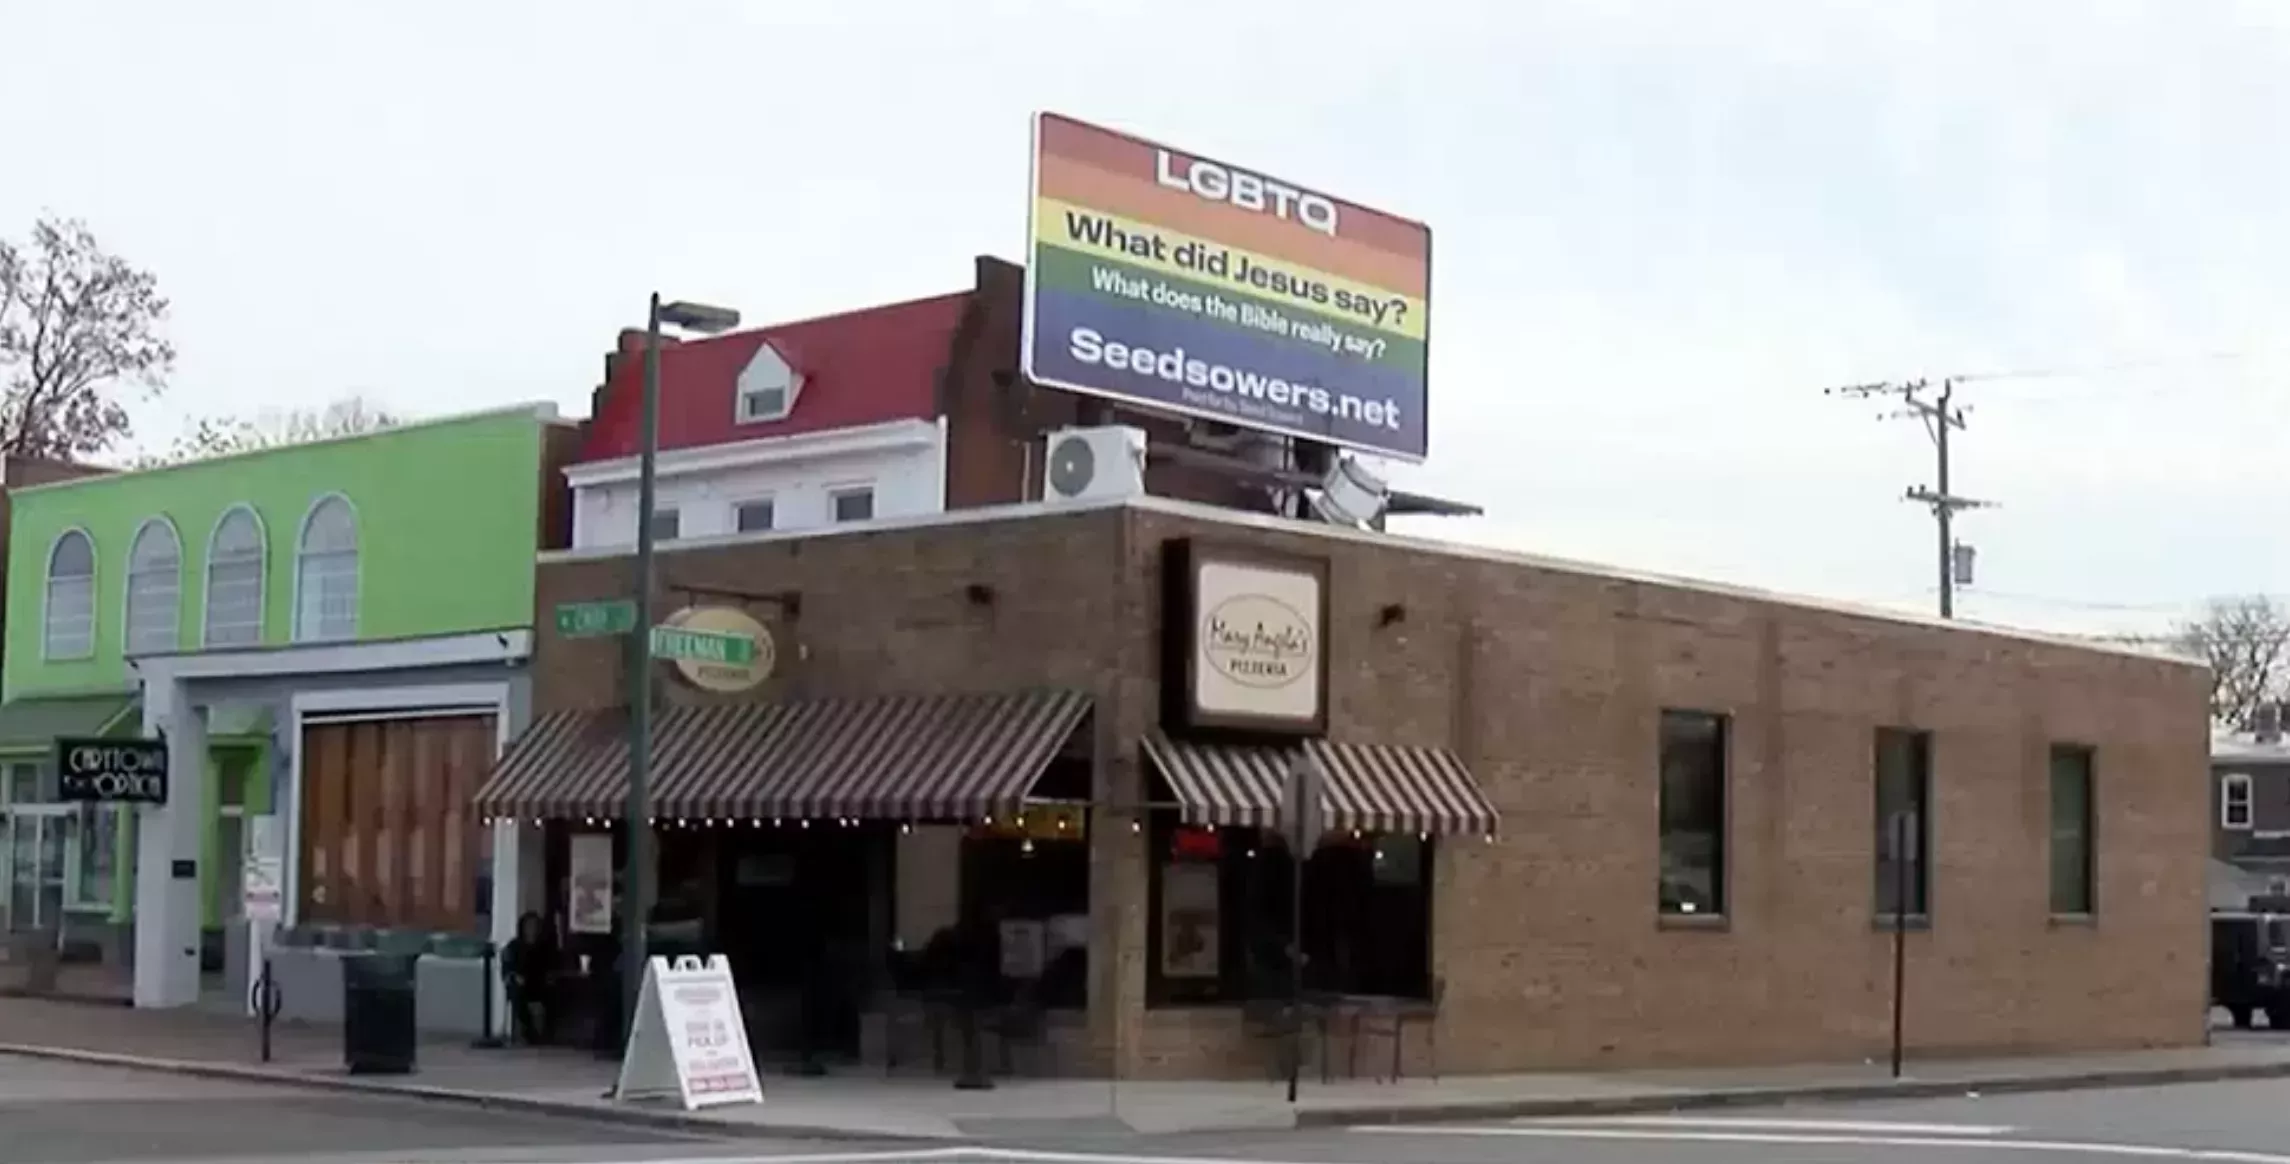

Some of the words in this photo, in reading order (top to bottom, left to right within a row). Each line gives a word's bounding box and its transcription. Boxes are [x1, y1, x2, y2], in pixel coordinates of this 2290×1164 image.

[1157, 150, 1338, 237] LGBTQ
[1066, 211, 1166, 262] What
[1174, 241, 1229, 278] did
[1234, 257, 1329, 304] Jesus
[1334, 288, 1408, 326] say?
[1092, 265, 1150, 303] What
[1153, 282, 1202, 313] does
[1204, 293, 1238, 324] the
[1240, 301, 1289, 337] Bible
[1291, 318, 1342, 351] really
[1344, 332, 1386, 361] say?
[1069, 327, 1401, 431] Seedsowers.net
